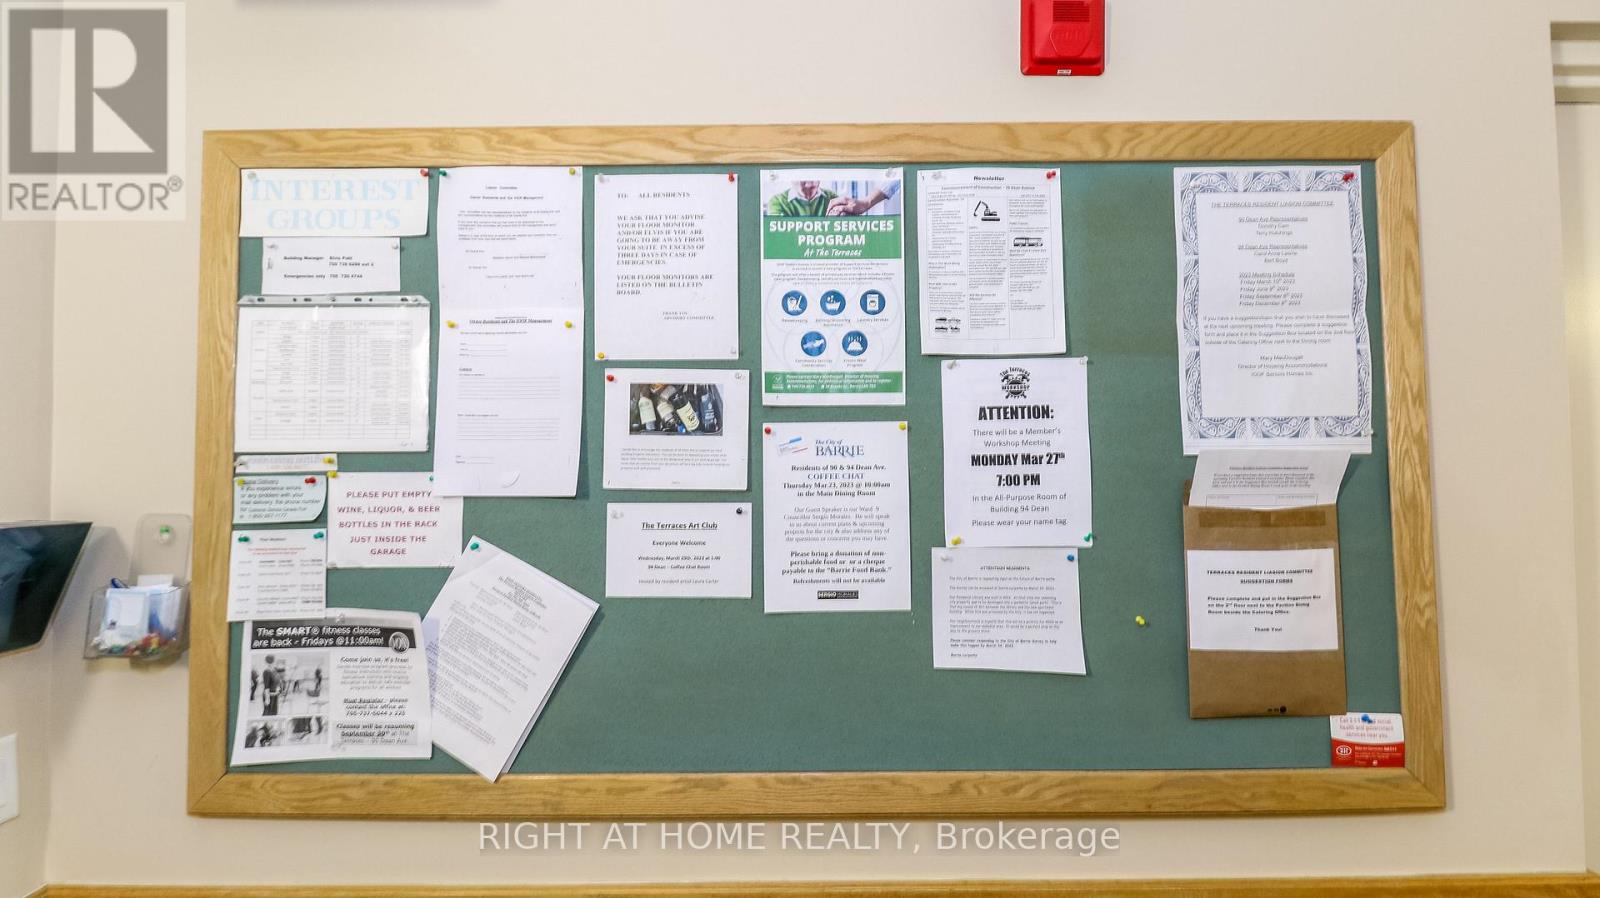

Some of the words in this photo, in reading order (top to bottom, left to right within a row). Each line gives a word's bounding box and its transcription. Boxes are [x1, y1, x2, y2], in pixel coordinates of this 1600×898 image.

[251, 179, 421, 201] INTEREST
[267, 208, 401, 230] GROUPS
[769, 221, 830, 232] SUPPORT
[834, 220, 894, 232] SERVICES
[798, 235, 865, 245] PROGRAM
[804, 248, 813, 256] At
[816, 248, 829, 256] The
[831, 248, 862, 256] Terraces
[978, 405, 1054, 420] ATTENTION:
[815, 446, 865, 457] BARRIE
[971, 453, 1019, 466] MONDAY
[1021, 453, 1043, 465] Mar
[996, 474, 1020, 486] 7:00
[1023, 473, 1041, 486] PM
[256, 628, 275, 636] The
[270, 638, 292, 646] back
[301, 638, 334, 646] Fridays
